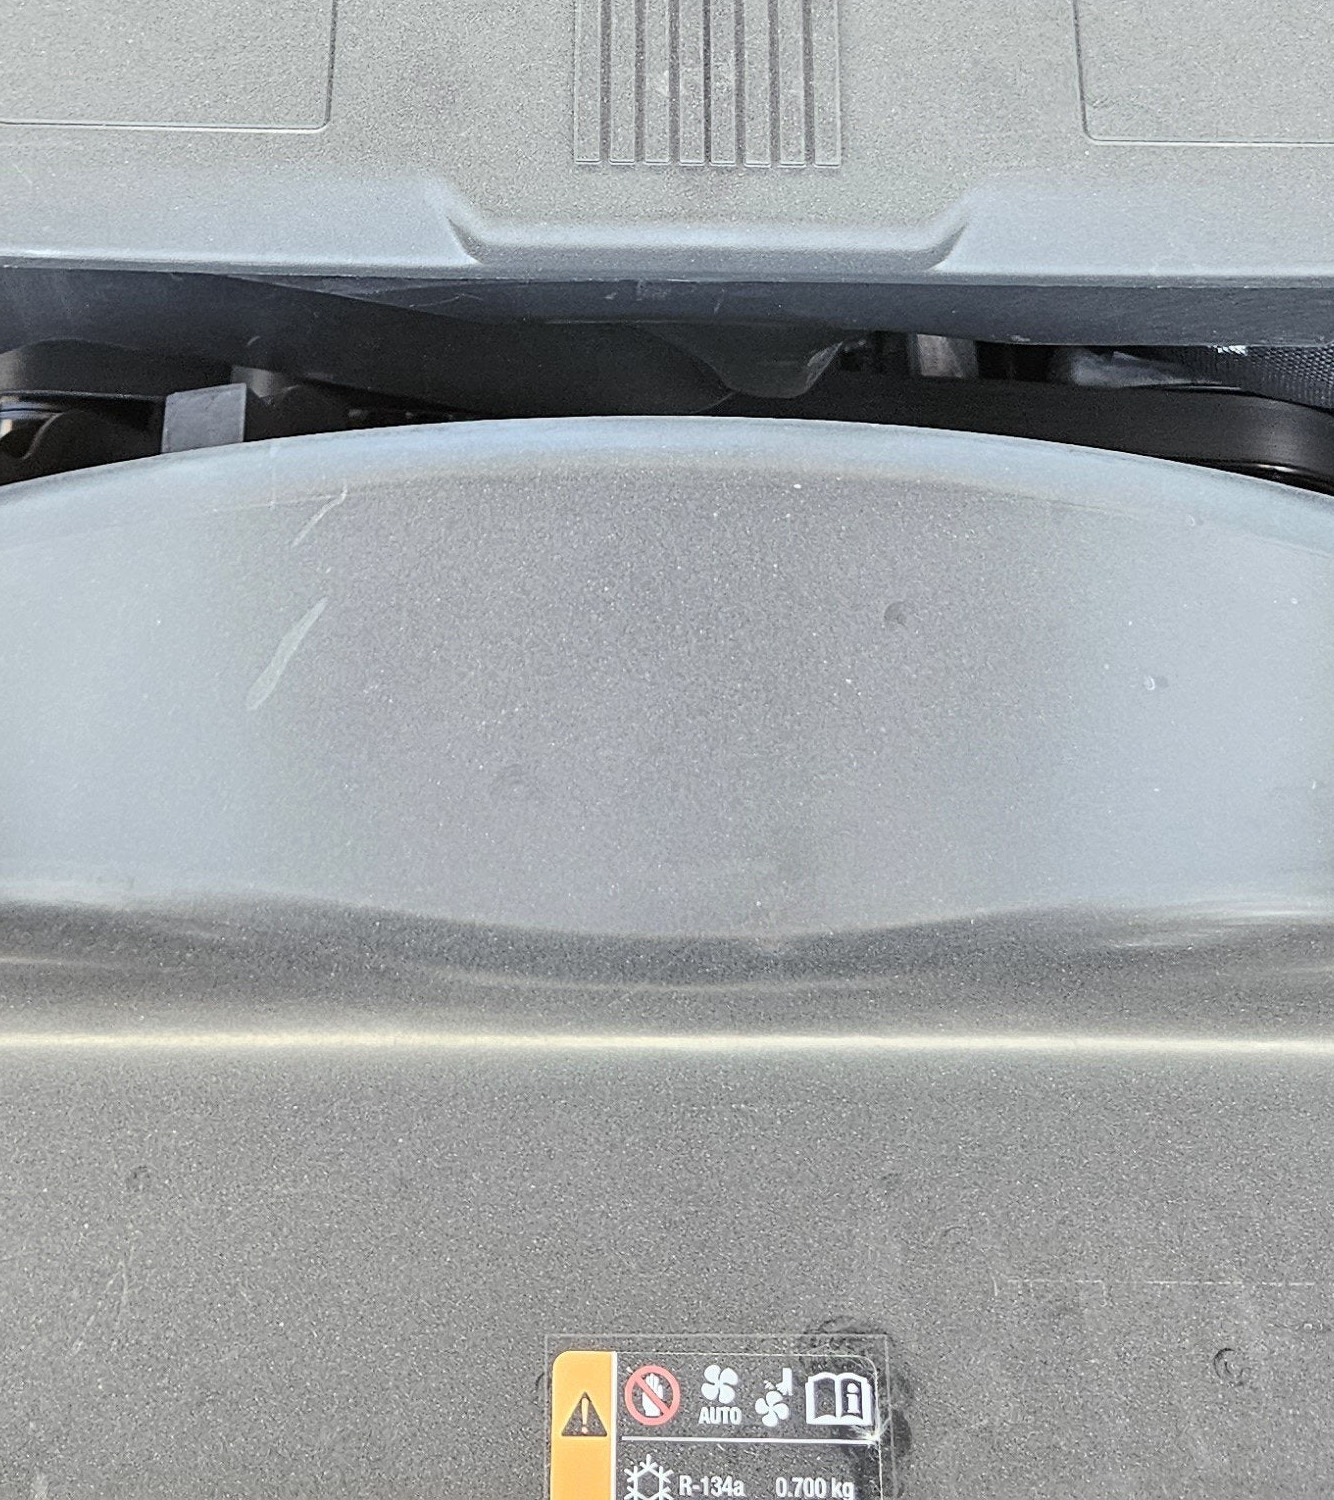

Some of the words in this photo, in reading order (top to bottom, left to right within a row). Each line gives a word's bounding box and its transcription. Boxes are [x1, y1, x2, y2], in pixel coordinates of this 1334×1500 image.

[698, 1406, 742, 1425] AUTO
[679, 1474, 745, 1497] R-134a
[775, 1476, 826, 1497] 0.700
[831, 1477, 855, 1500] kg
